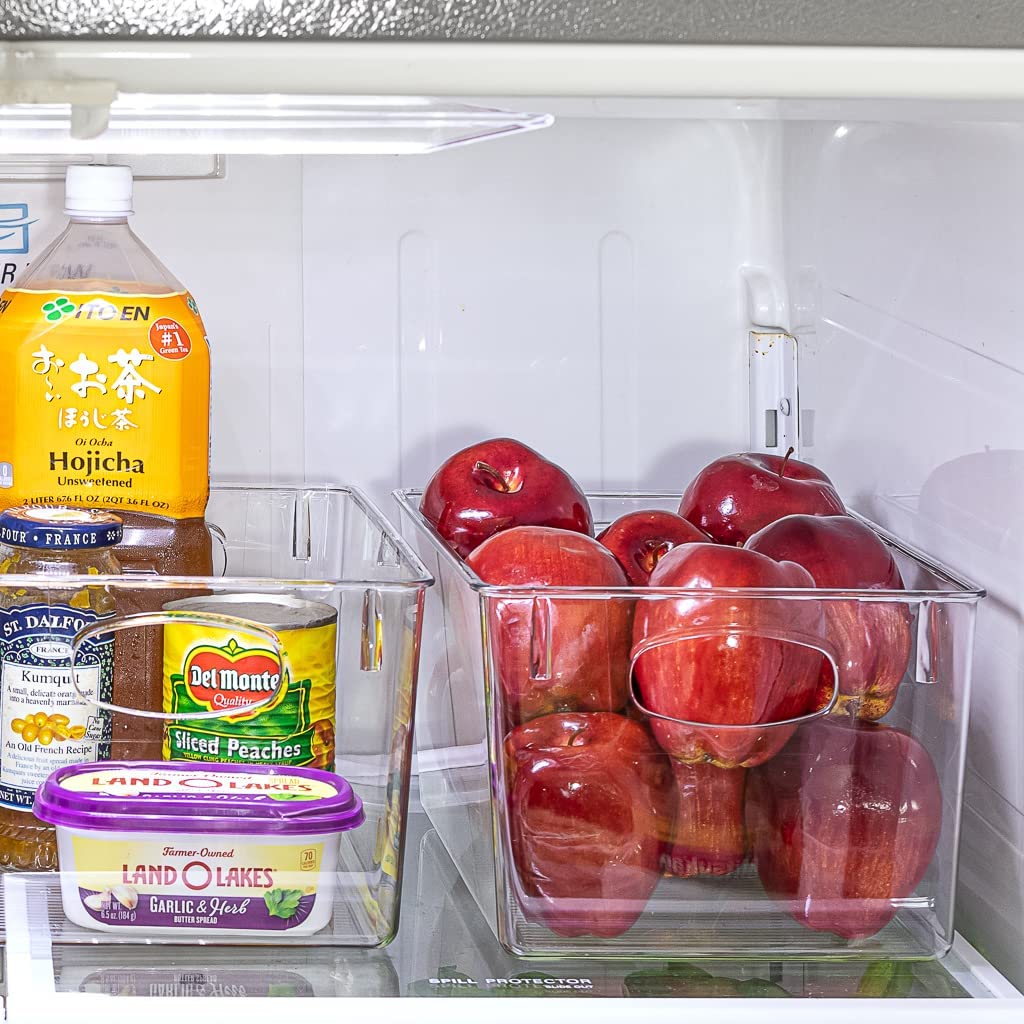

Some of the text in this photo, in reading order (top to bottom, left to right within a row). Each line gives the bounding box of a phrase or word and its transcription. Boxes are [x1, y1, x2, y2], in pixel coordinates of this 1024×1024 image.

[120, 306, 150, 320] EN
[161, 331, 184, 346] #1
[69, 348, 163, 404] お茶
[58, 407, 139, 431] ほうじ茶
[75, 438, 113, 447] Oi Ocha
[49, 450, 145, 476] Hojicha
[57, 476, 133, 488] Unsweetened
[30, 496, 54, 505] LITER
[86, 495, 100, 503] OZ
[102, 496, 124, 505] (2QT
[126, 497, 138, 505] 3.6
[140, 499, 151, 507] FL
[152, 501, 170, 510] OZ)
[45, 532, 97, 545] FRANCE
[3, 614, 96, 637] ST. DALFO
[22, 670, 80, 687] Kumqut
[190, 665, 279, 692] Del Monte
[213, 693, 252, 706] Quality
[5, 740, 92, 755] An Old French Recipe
[175, 730, 301, 760] Sliced Peaches
[92, 777, 172, 786] LAND
[229, 781, 313, 791] LAKES
[0, 790, 33, 805] NET WT.
[162, 846, 235, 858] Farmer-Owned
[304, 851, 313, 861] 70
[122, 860, 274, 891] LAND O LAKES
[150, 896, 250, 915] GARLIC & Herb
[118, 911, 130, 920] (184
[173, 915, 218, 924] BUTTER SPREAD
